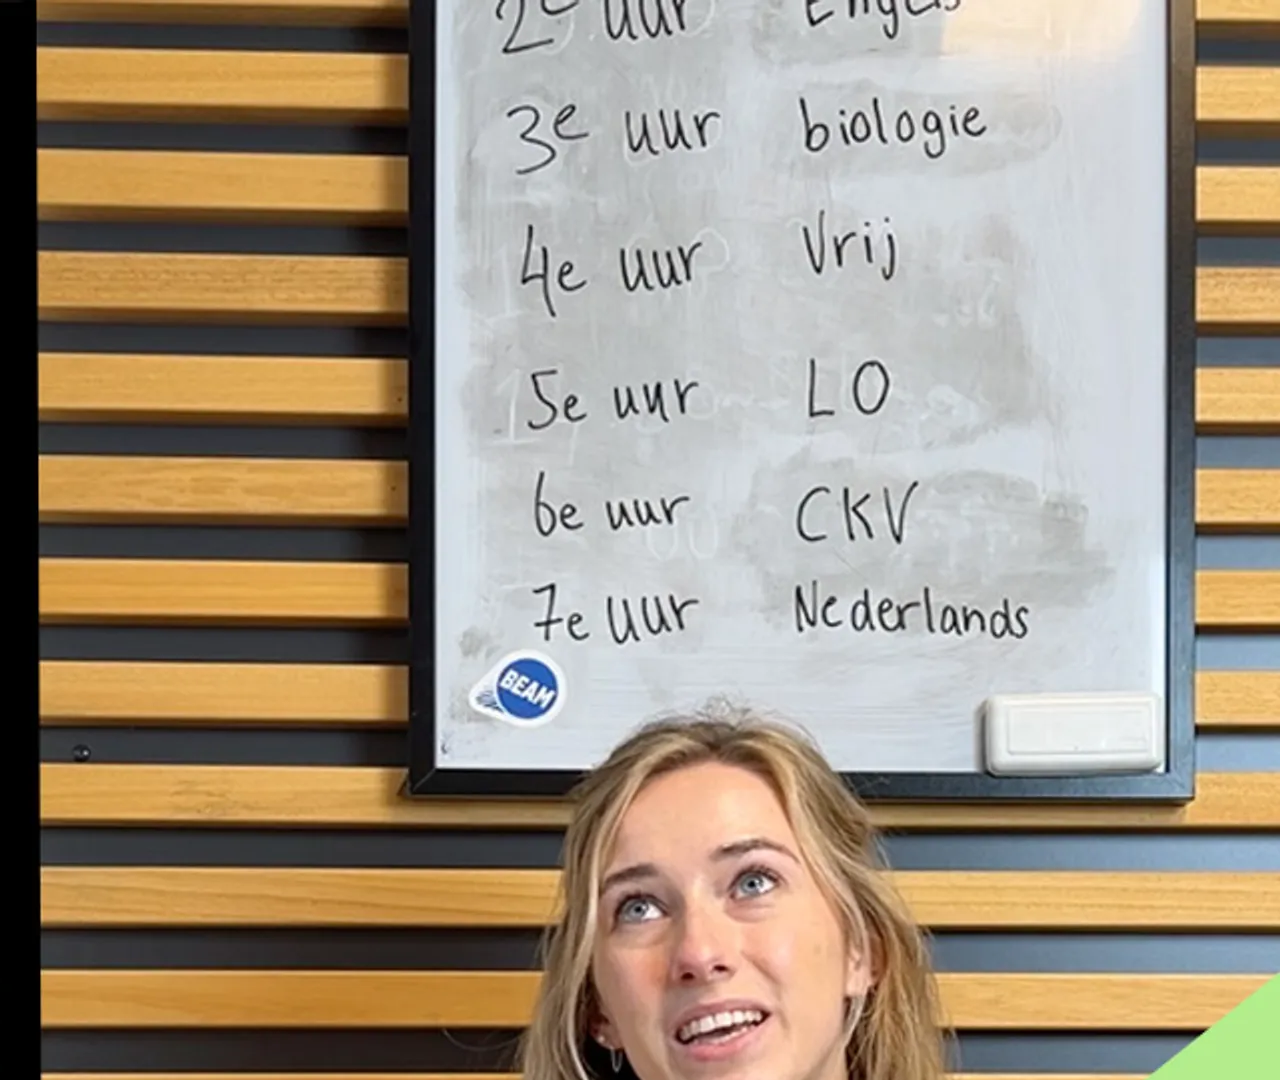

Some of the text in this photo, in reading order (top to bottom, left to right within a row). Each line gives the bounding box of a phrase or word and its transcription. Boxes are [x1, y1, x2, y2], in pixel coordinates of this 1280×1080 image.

[506, 96, 988, 176] 3e uur biologie
[519, 209, 896, 319] 4e uur Vrij
[526, 357, 891, 431] 5e uur LO
[533, 470, 920, 546] 6e uur CKV
[531, 579, 1030, 646] 7e uur Nederlands
[500, 668, 556, 709] BEAM
